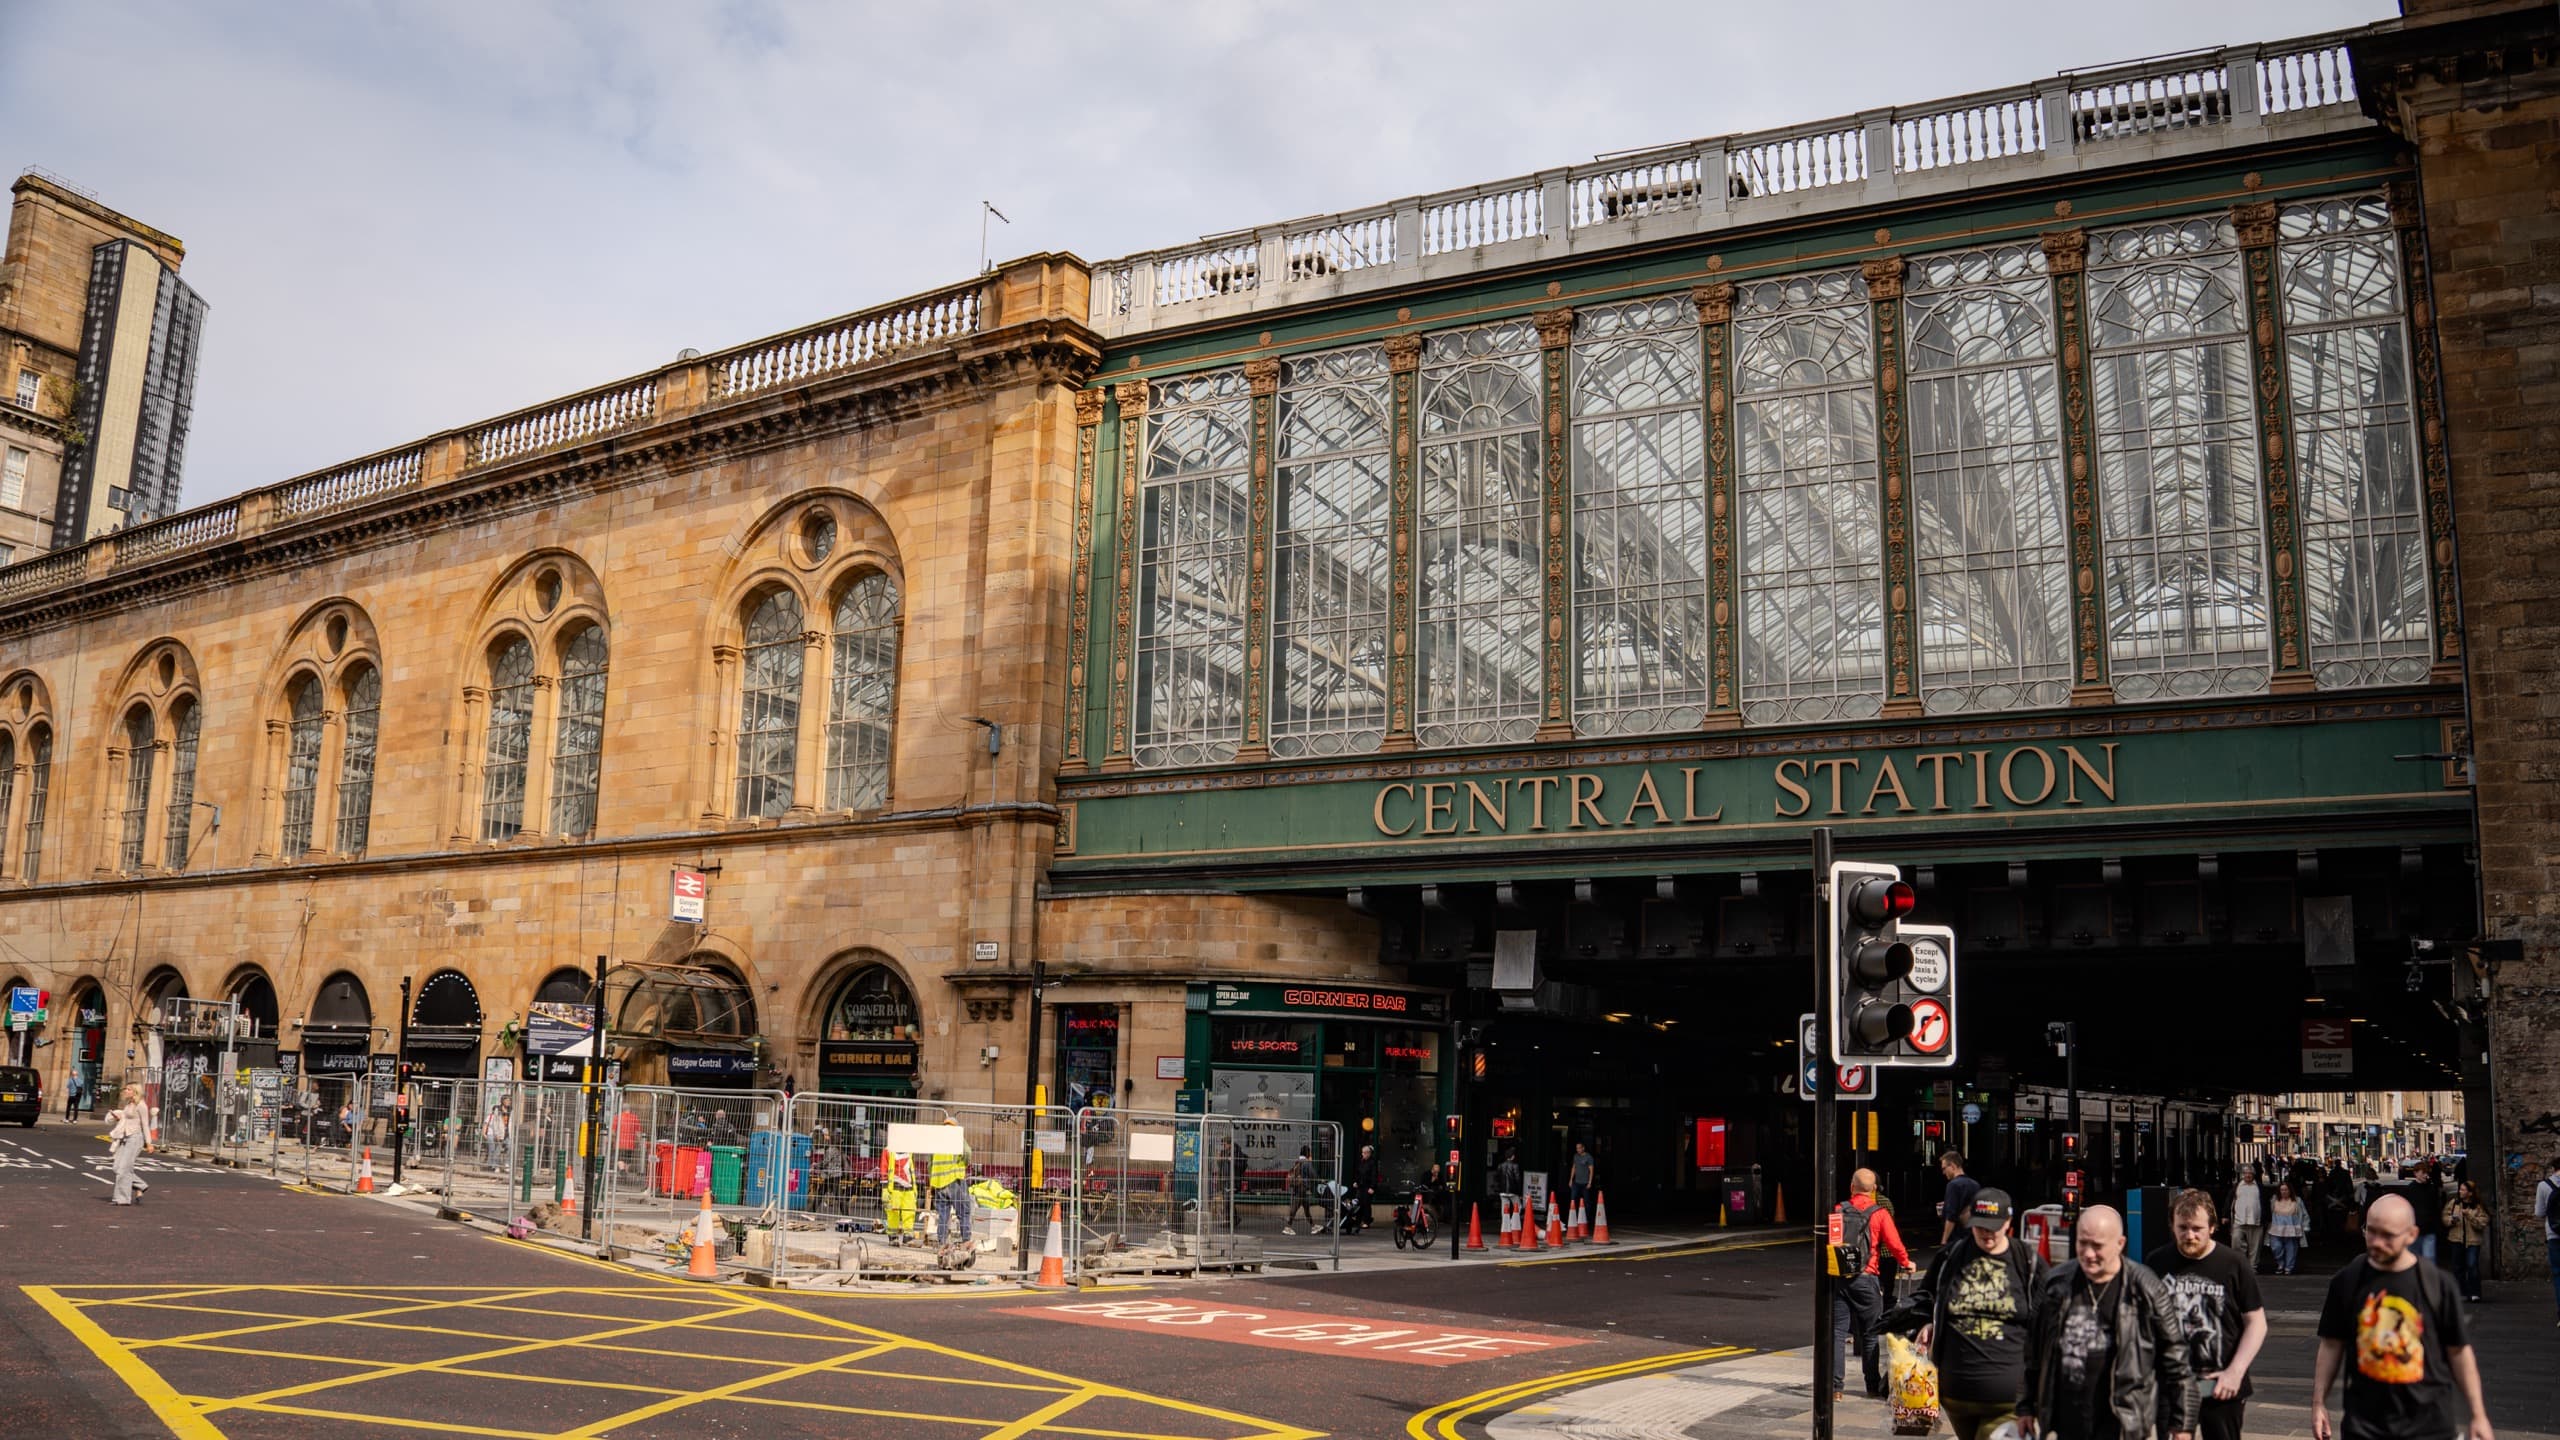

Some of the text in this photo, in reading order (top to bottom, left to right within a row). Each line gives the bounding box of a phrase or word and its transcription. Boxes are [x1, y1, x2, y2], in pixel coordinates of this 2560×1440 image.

[1372, 742, 2121, 837] CENTRAL STATION
[1915, 946, 1938, 956] Except
[1915, 957, 1938, 966] buses,
[1933, 966, 1938, 974] &
[1915, 976, 1937, 984] cycles
[1216, 991, 1250, 1000] OPEN ALL DAY
[1284, 990, 1369, 1008] CORNER
[1373, 994, 1406, 1012] BAR
[848, 1004, 908, 1017] CORNER BAR
[1068, 1019, 1096, 1029] PUBLIC
[1231, 1040, 1298, 1052] LIVE SPORTS
[829, 1053, 912, 1065] CORNER BAR
[1385, 1047, 1432, 1059] PUBLIC HOUSE
[551, 1061, 574, 1075] Juicy
[672, 1057, 722, 1069] Glasgow Central
[1246, 1135, 1276, 1148] BAR
[2162, 1273, 2225, 1296] Sabaton
[1046, 1301, 1550, 1357] BUS GATE
